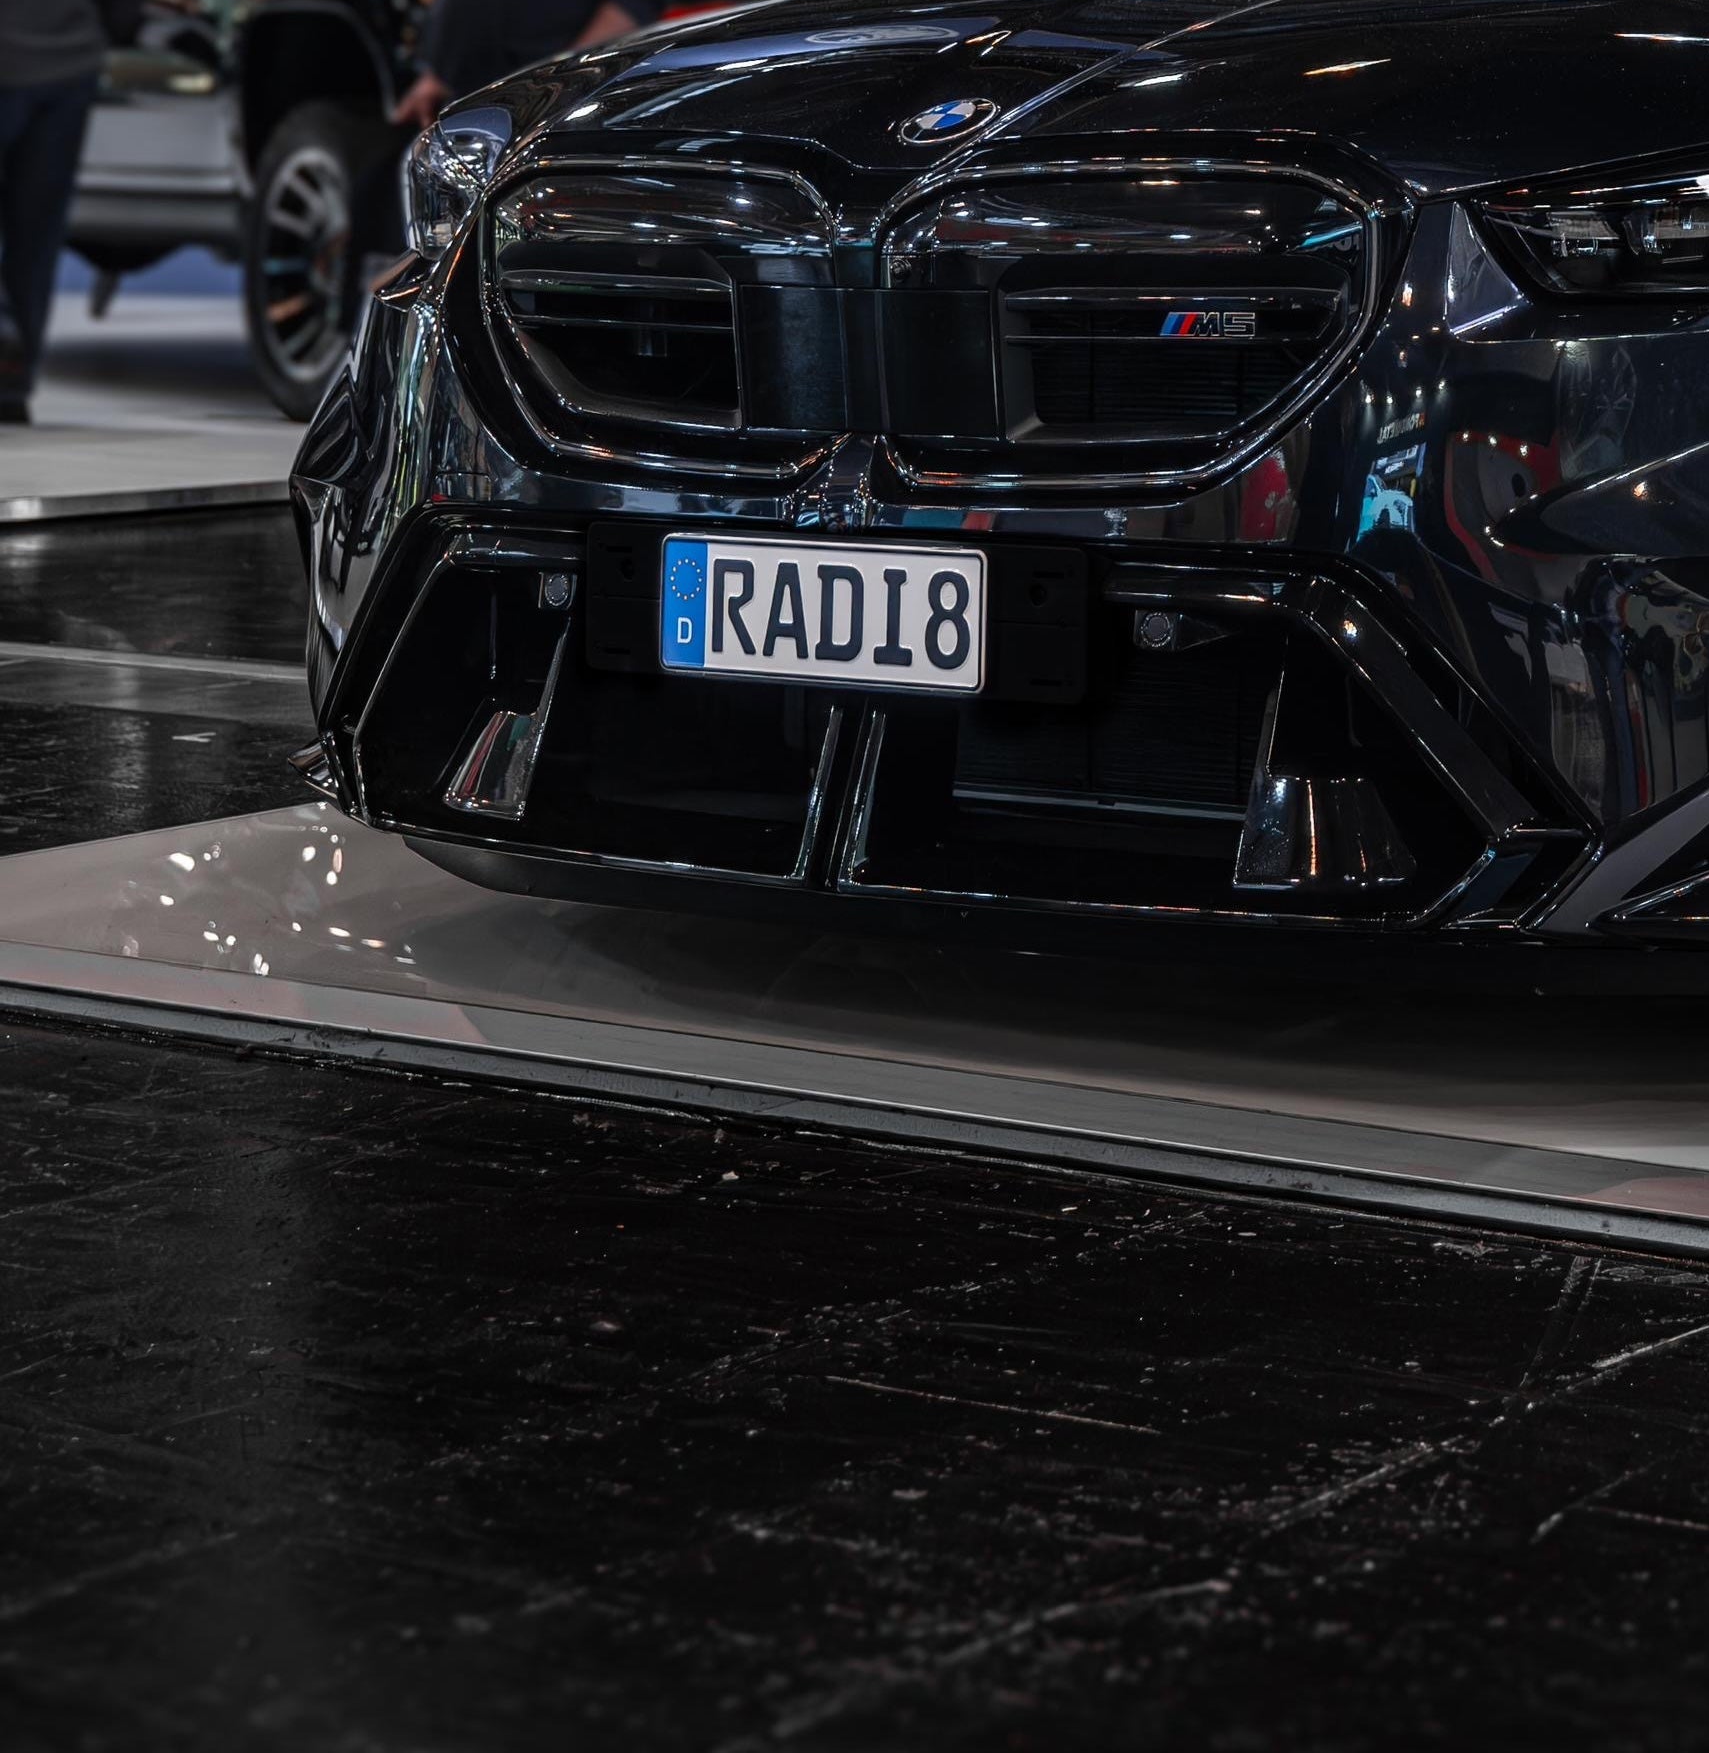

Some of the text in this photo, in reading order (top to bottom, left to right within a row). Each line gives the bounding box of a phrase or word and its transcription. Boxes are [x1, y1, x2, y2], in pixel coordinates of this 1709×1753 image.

[1188, 312, 1255, 337] M5
[711, 558, 970, 670] RADI8
[676, 616, 693, 644] D
